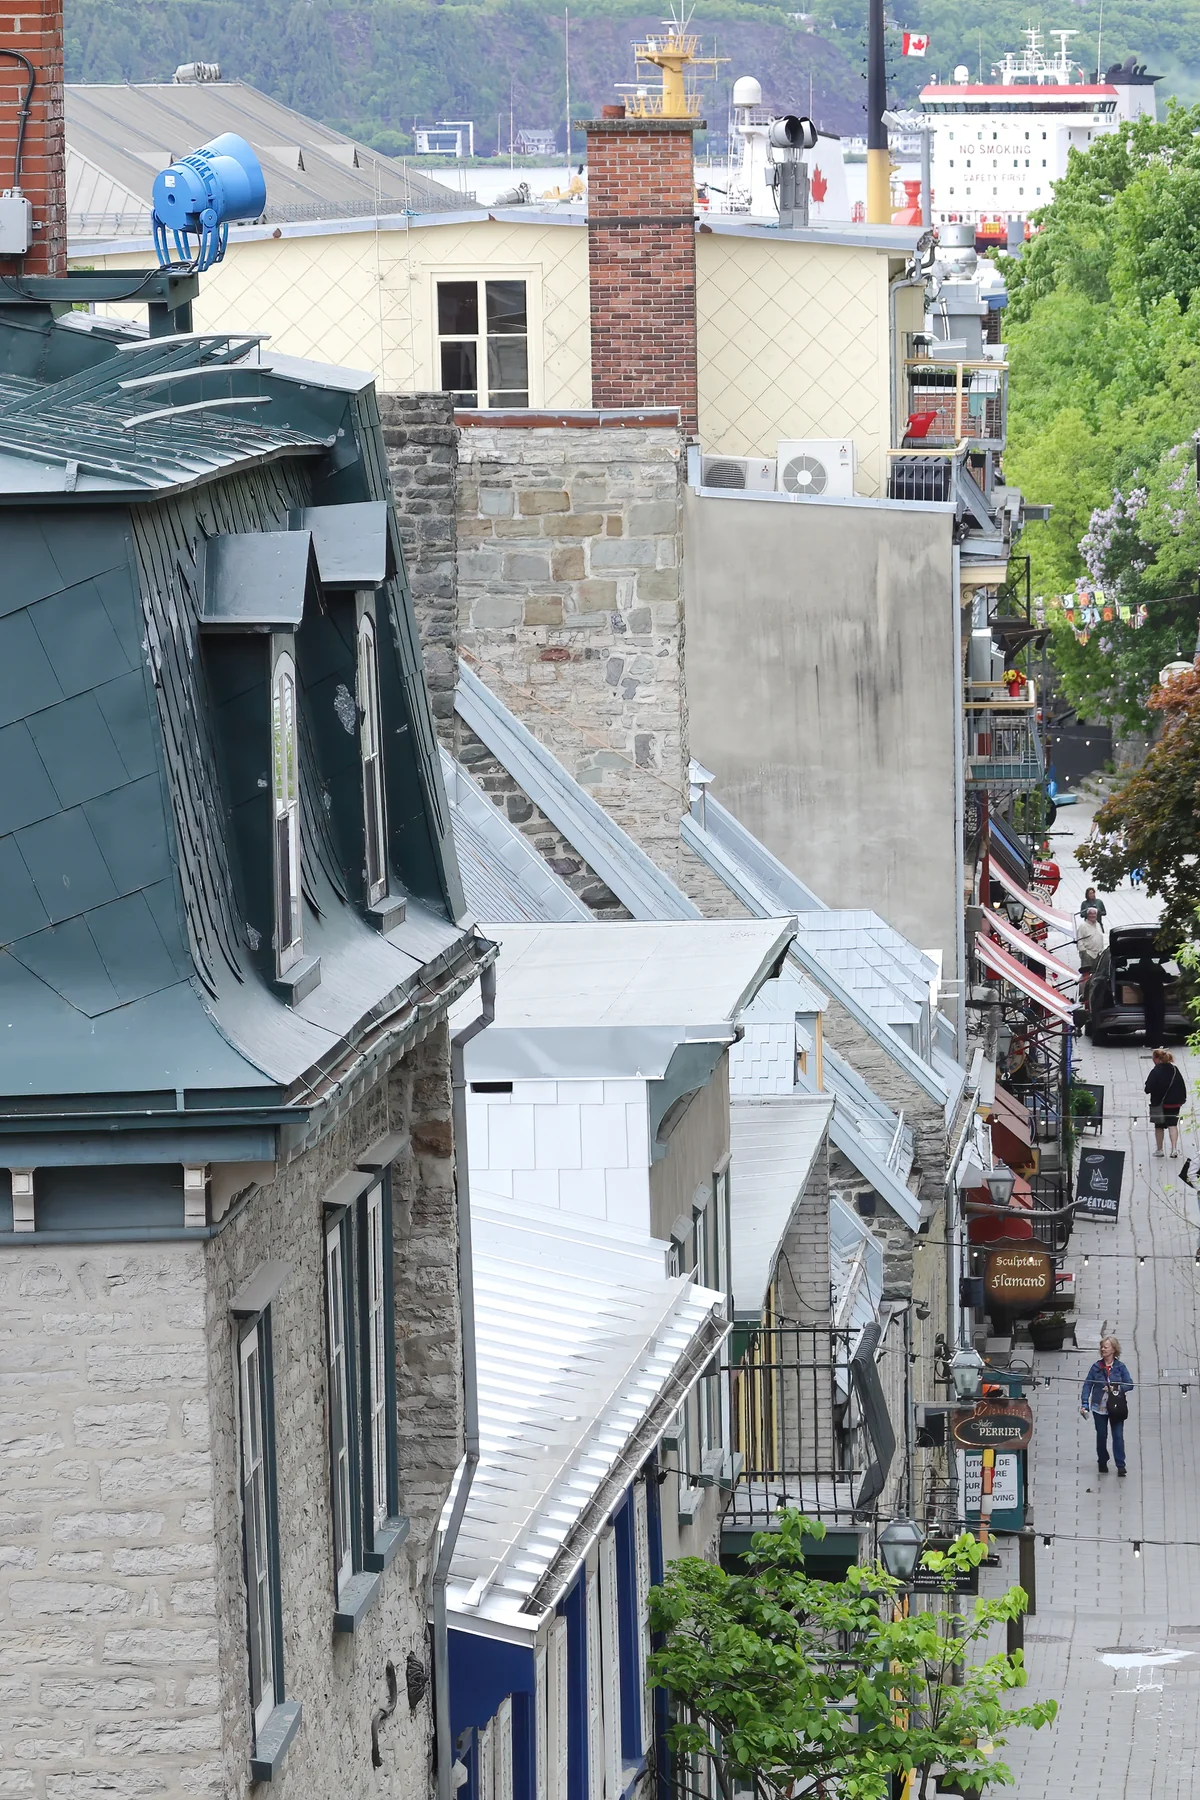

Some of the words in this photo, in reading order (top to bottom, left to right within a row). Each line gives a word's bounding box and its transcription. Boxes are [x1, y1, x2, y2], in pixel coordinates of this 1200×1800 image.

[959, 144, 975, 154] NO
[979, 144, 1032, 154] SMOKING
[963, 173, 997, 182] SAFETY
[995, 1255, 1043, 1268] Sculpteur
[991, 1273, 1046, 1289] Flamand
[979, 1427, 1022, 1440] PERRIER
